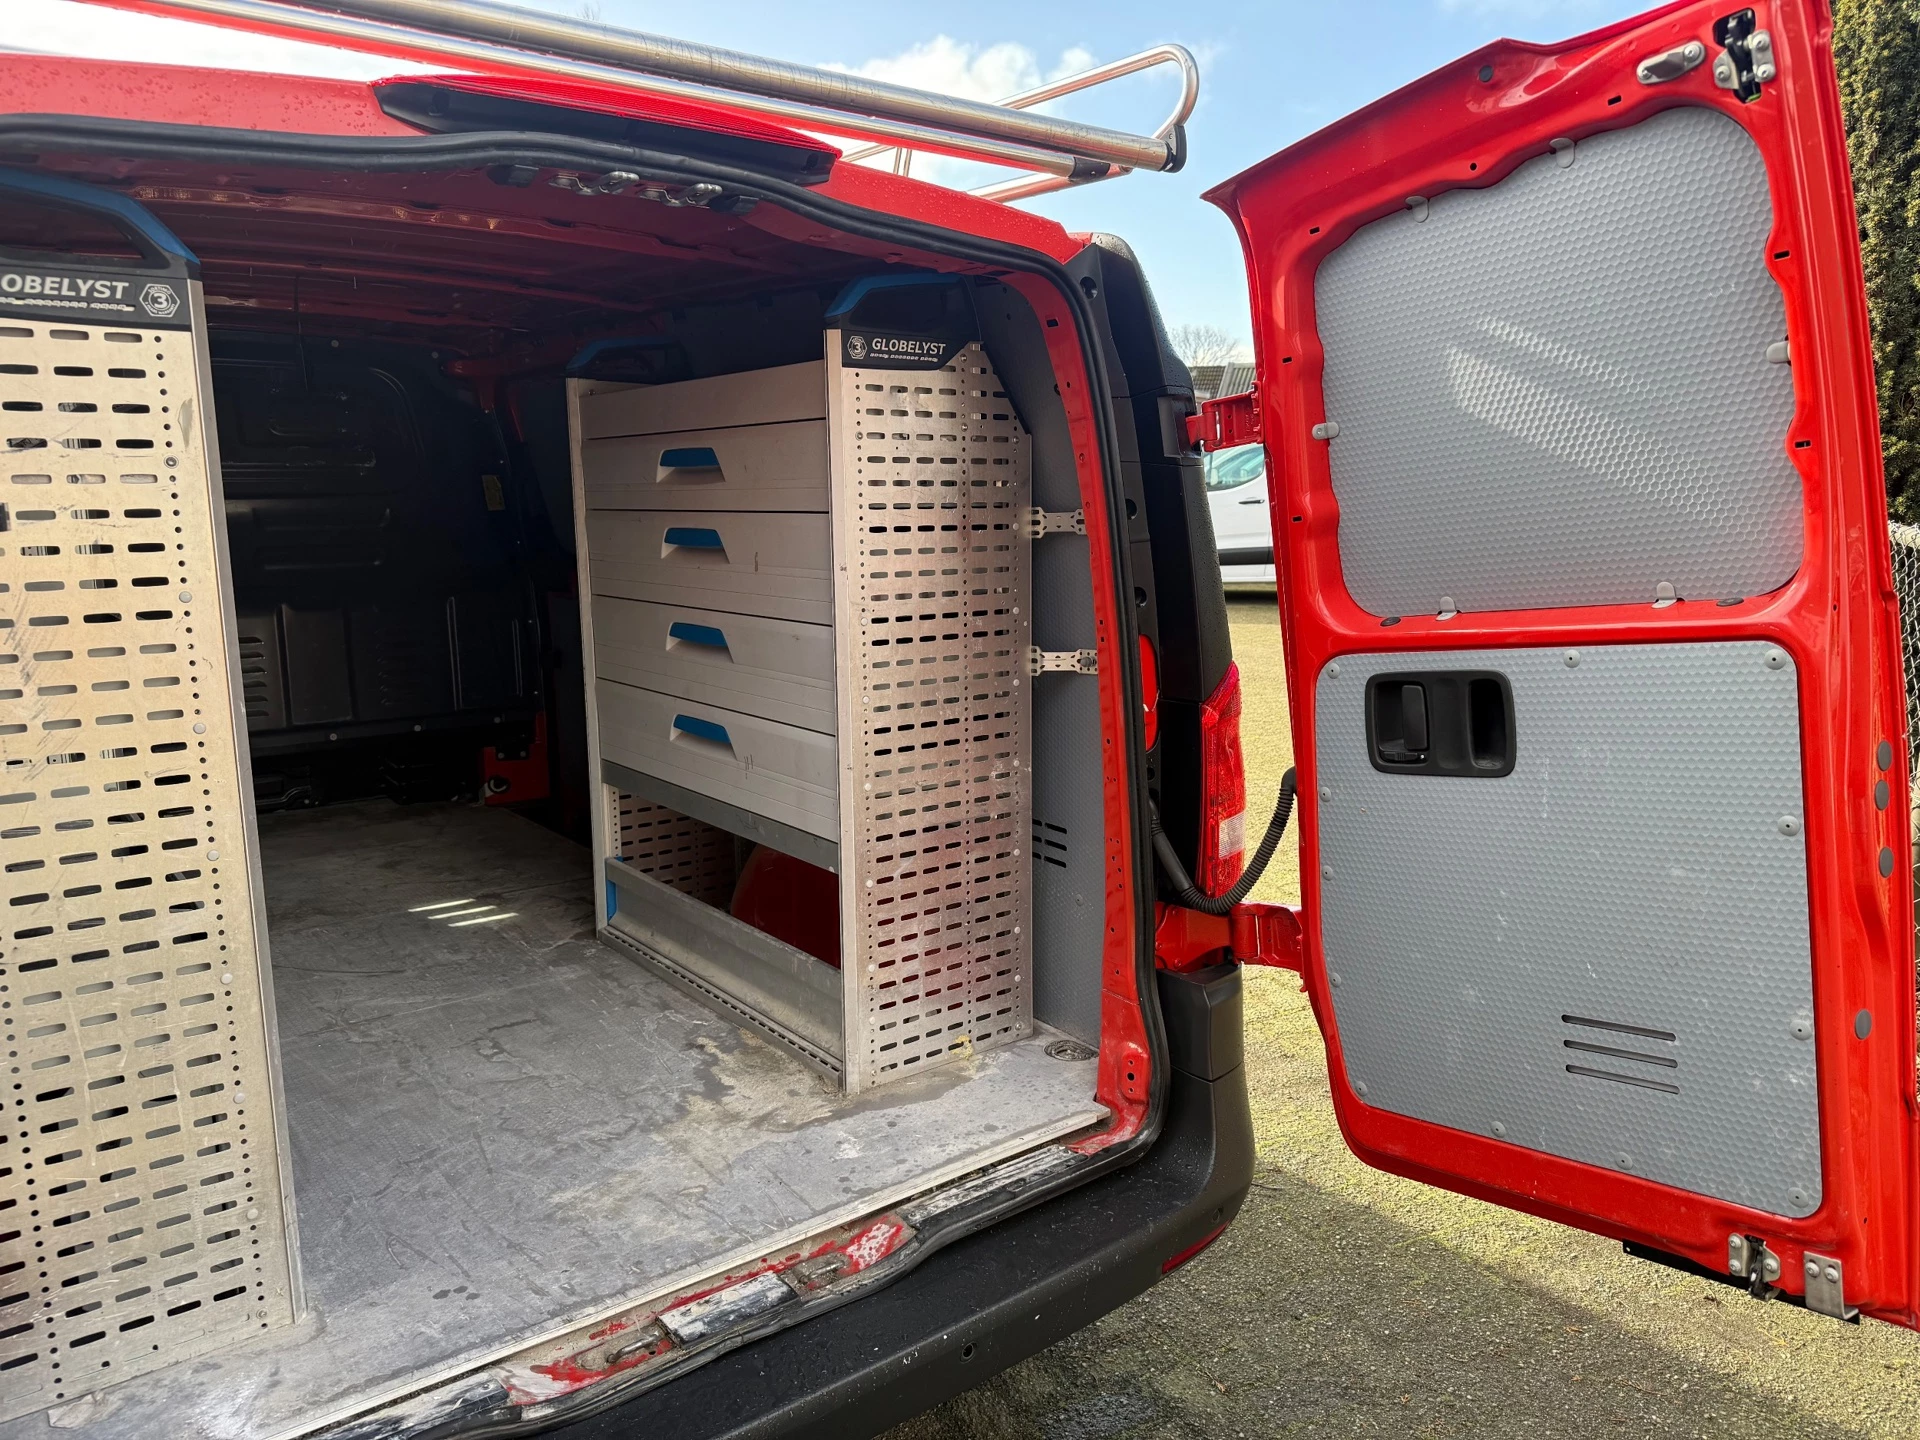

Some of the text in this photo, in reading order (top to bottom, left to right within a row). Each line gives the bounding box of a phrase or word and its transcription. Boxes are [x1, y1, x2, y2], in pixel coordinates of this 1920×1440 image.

[153, 293, 168, 308] 3
[854, 342, 862, 352] 3
[872, 338, 946, 354] GLOBELYST
